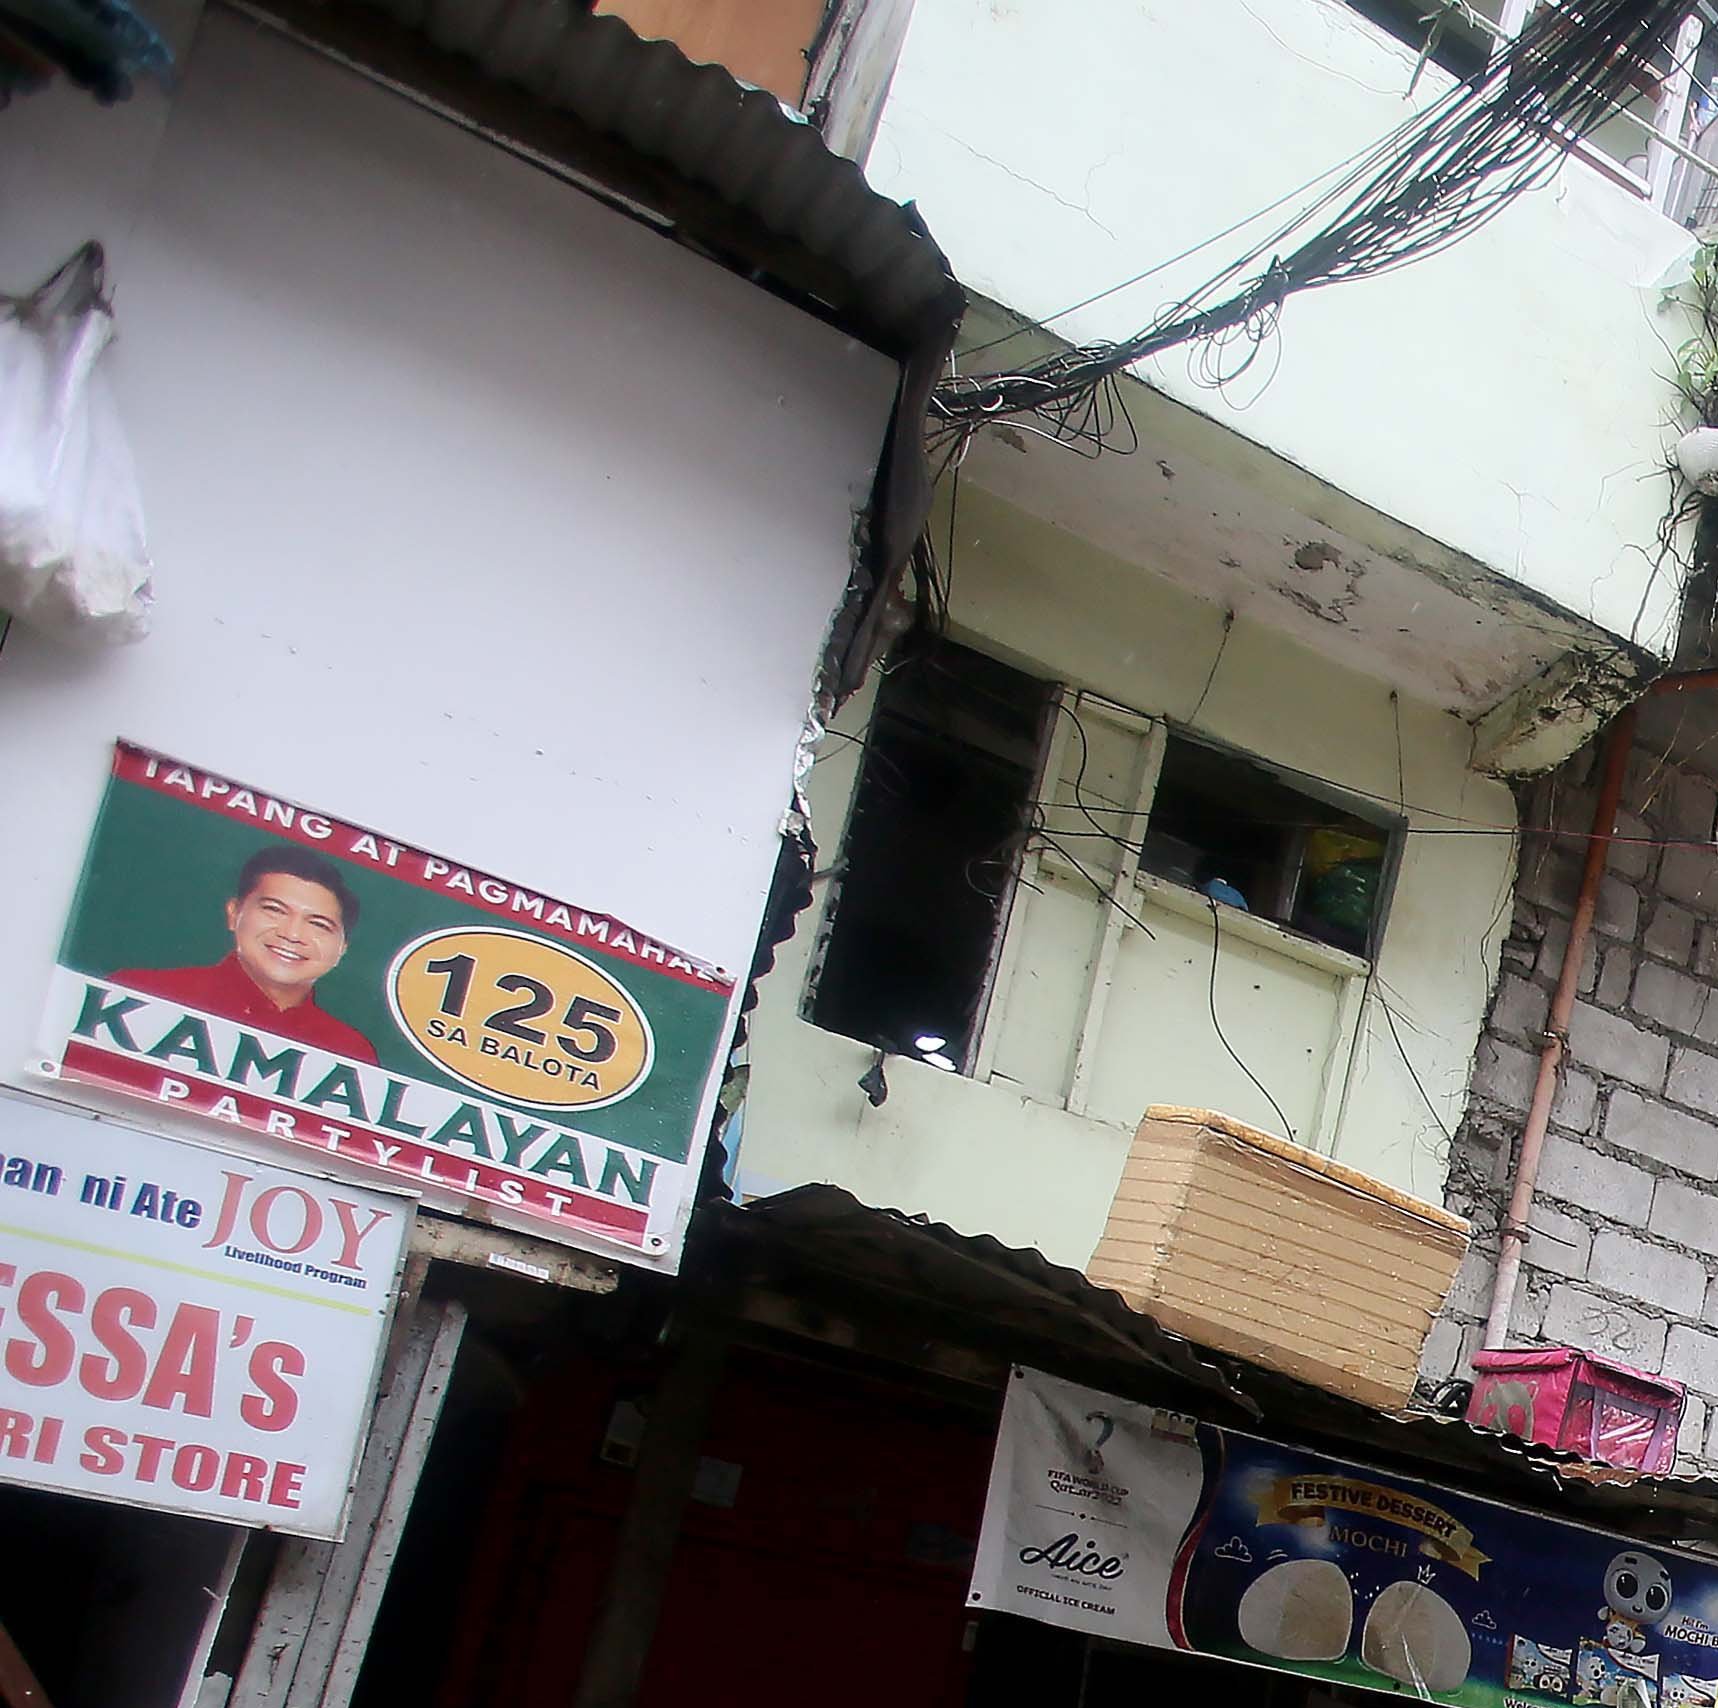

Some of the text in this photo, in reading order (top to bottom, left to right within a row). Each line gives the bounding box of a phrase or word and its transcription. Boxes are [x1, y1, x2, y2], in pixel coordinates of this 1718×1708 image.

[350, 835, 407, 866] AT
[424, 955, 624, 1066] 125
[427, 1017, 601, 1091] SA BALOTA
[72, 983, 661, 1206] KAMALAYAN
[158, 1077, 573, 1218] PARTYLIST
[0, 1152, 392, 1271] an ni Ate JOY
[225, 1246, 366, 1289] Livelihood Program
[80, 1426, 306, 1509] STORE
[1291, 1482, 1457, 1539] FESTIVE DESSERT
[1329, 1526, 1409, 1558] MOCHI
[1020, 1533, 1124, 1580] Aice
[1664, 1625, 1709, 1645] MOCHI
